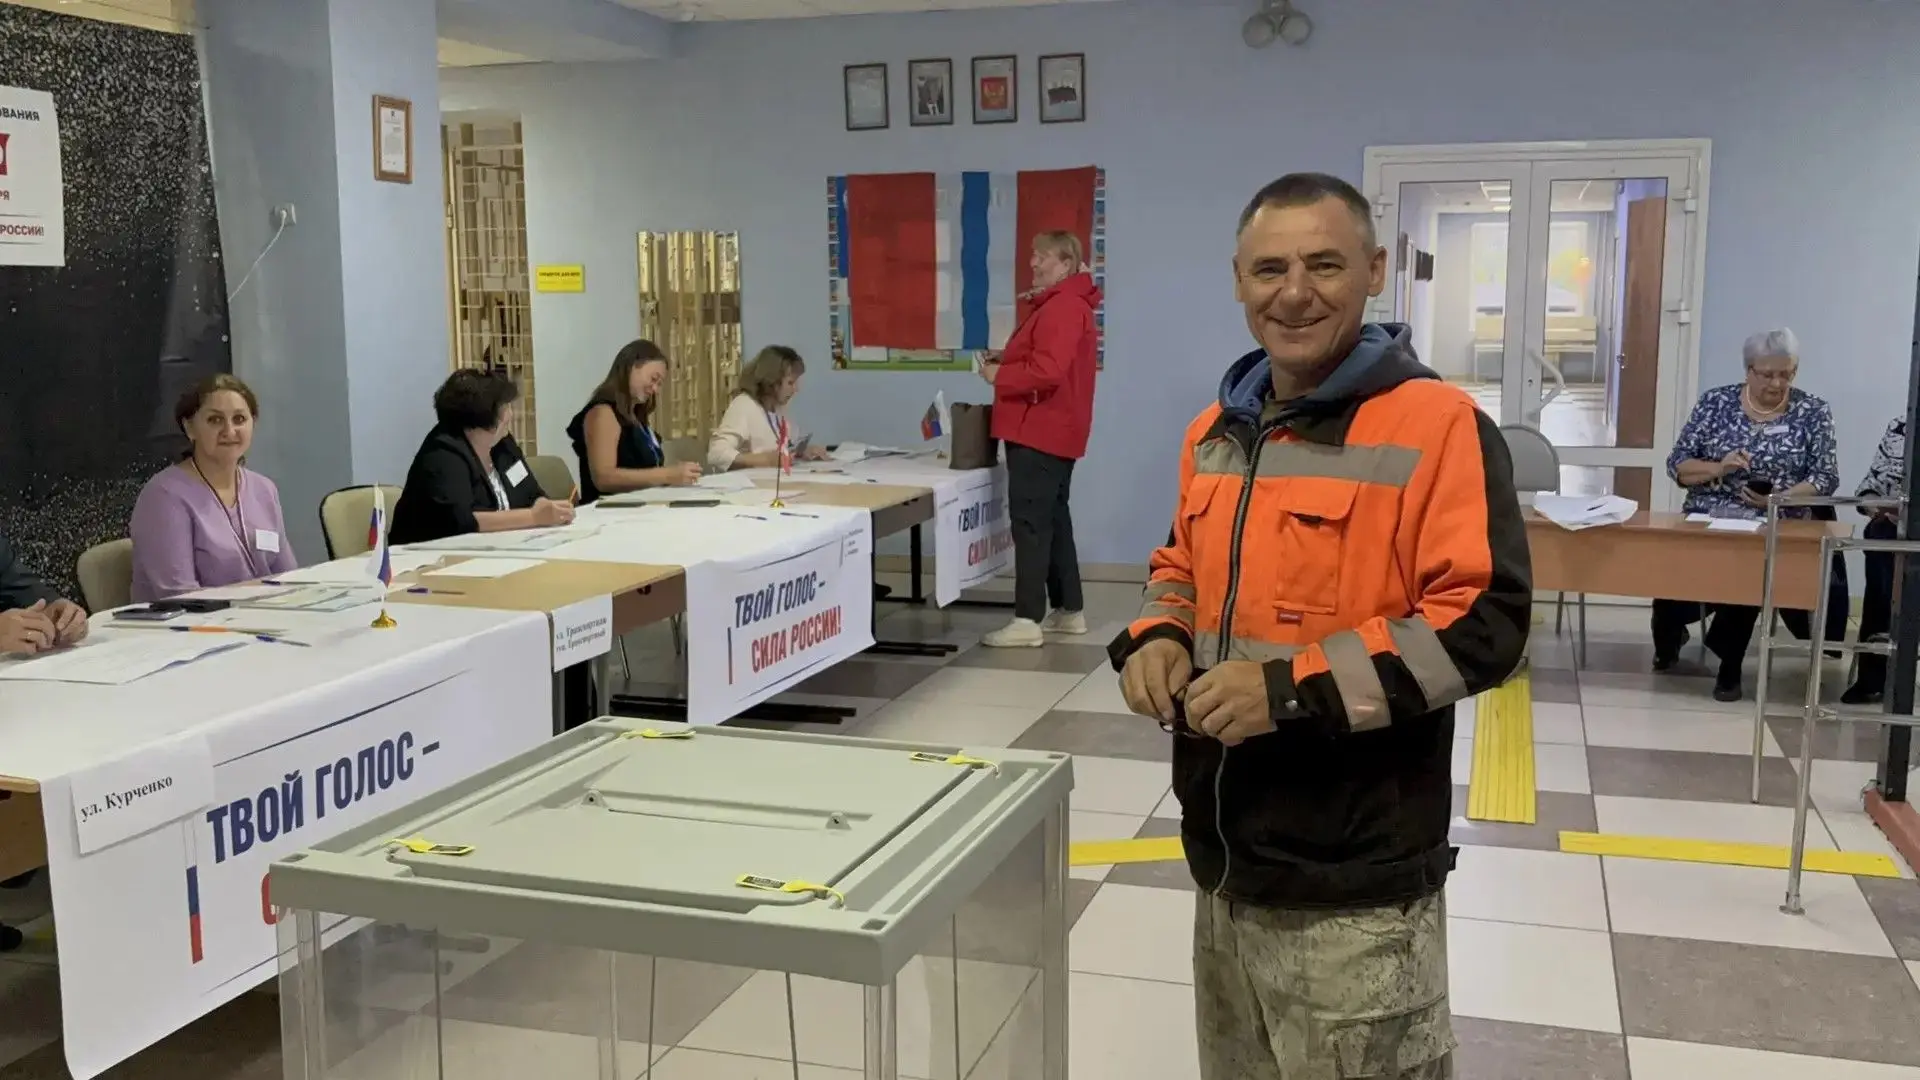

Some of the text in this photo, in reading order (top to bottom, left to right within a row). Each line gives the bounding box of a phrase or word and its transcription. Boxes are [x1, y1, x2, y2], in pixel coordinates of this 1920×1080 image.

[0, 106, 40, 121] ВАНИЯ
[0, 223, 44, 237] РОССИИ!
[735, 582, 775, 628] ТВОЙ
[776, 570, 817, 615] ГОЛОС
[751, 604, 841, 673] СИЛА РОССИИ!
[80, 776, 173, 822] ул. Курченко
[206, 768, 305, 864] ТВОЙ
[315, 731, 415, 820] ГОЛОС
